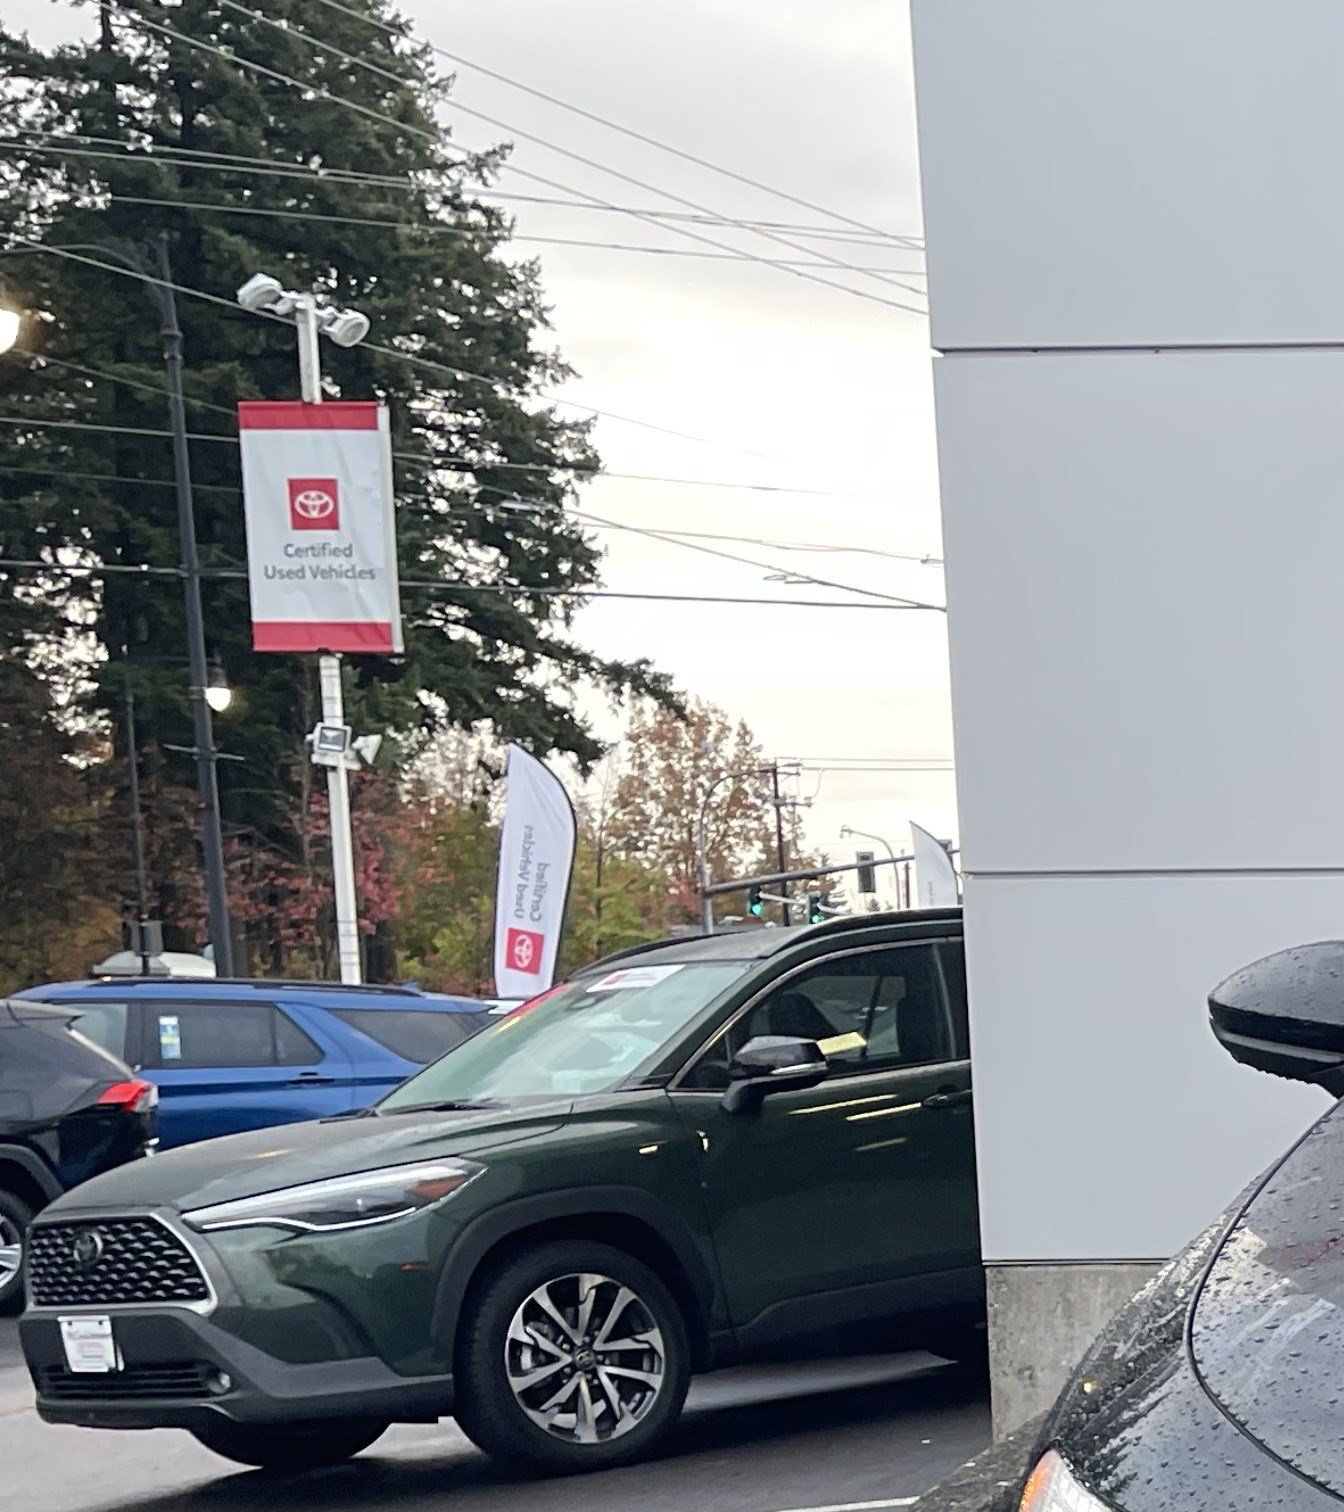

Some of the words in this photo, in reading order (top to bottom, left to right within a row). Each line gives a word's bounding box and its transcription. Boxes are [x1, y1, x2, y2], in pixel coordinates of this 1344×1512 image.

[283, 543, 353, 558] Certified
[264, 564, 305, 580] Used
[309, 564, 376, 580] Vehicles
